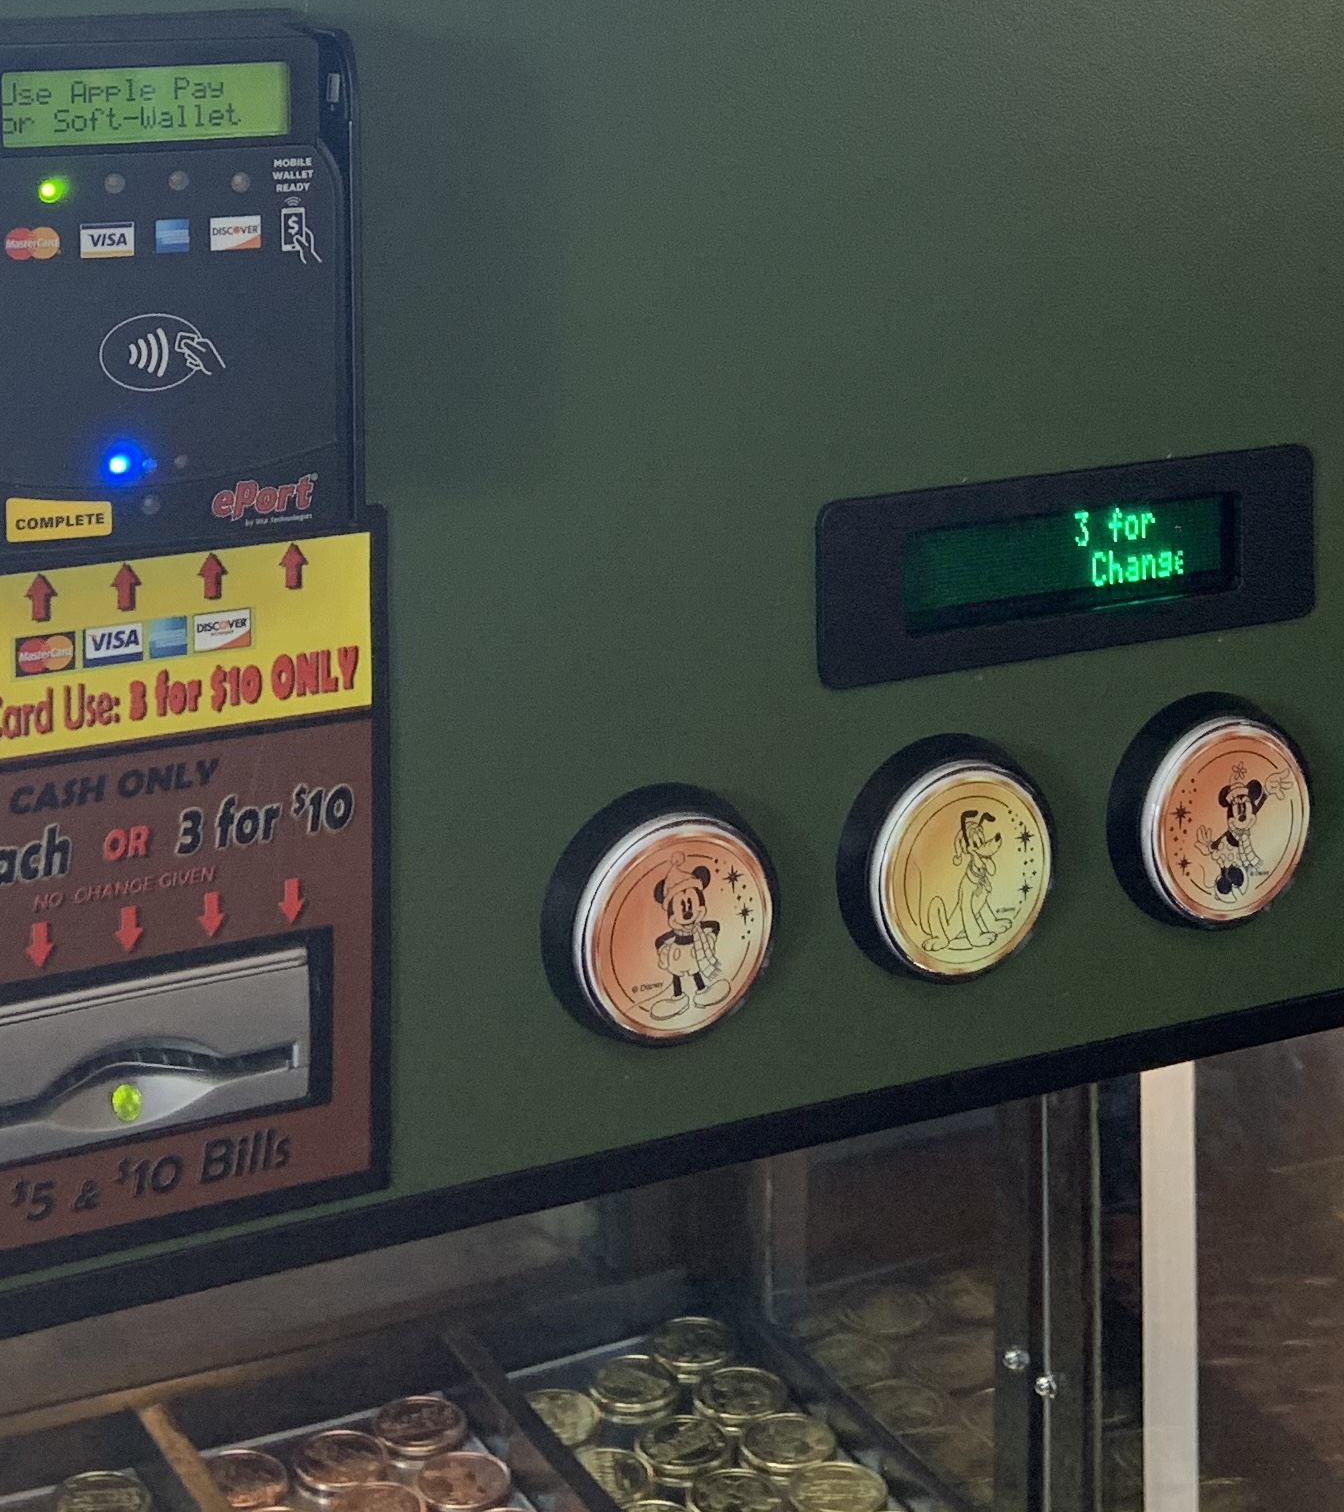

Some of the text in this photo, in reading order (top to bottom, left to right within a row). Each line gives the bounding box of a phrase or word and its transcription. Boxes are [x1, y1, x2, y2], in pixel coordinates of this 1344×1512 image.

[70, 78, 156, 104] Apple
[173, 76, 225, 100] Pay
[54, 103, 242, 134] Soft-Wallet
[272, 169, 314, 180] WALLET
[273, 157, 312, 168] MOBILE
[276, 182, 311, 193] READY
[88, 232, 128, 248] VISA
[212, 224, 259, 237] DISCOVER
[211, 474, 315, 522] ePort
[15, 513, 106, 531] COMPLETE
[1074, 507, 1156, 547] 3 for
[196, 617, 248, 633] DISCOVER
[90, 628, 140, 652] VISA
[63, 683, 121, 731] Use:
[155, 669, 202, 716] for
[211, 663, 263, 712] $10
[271, 644, 360, 701] ONLY
[10, 758, 221, 815] CASH ONLY
[102, 825, 151, 862] OR
[174, 807, 203, 856] 3
[214, 793, 282, 851] for
[290, 783, 355, 836] $10
[34, 865, 216, 912] NO CHANGE GIVEN
[9, 1177, 55, 1222] $5
[72, 1180, 104, 1211] &
[113, 1152, 185, 1197] $10
[198, 1127, 293, 1184] Bills
